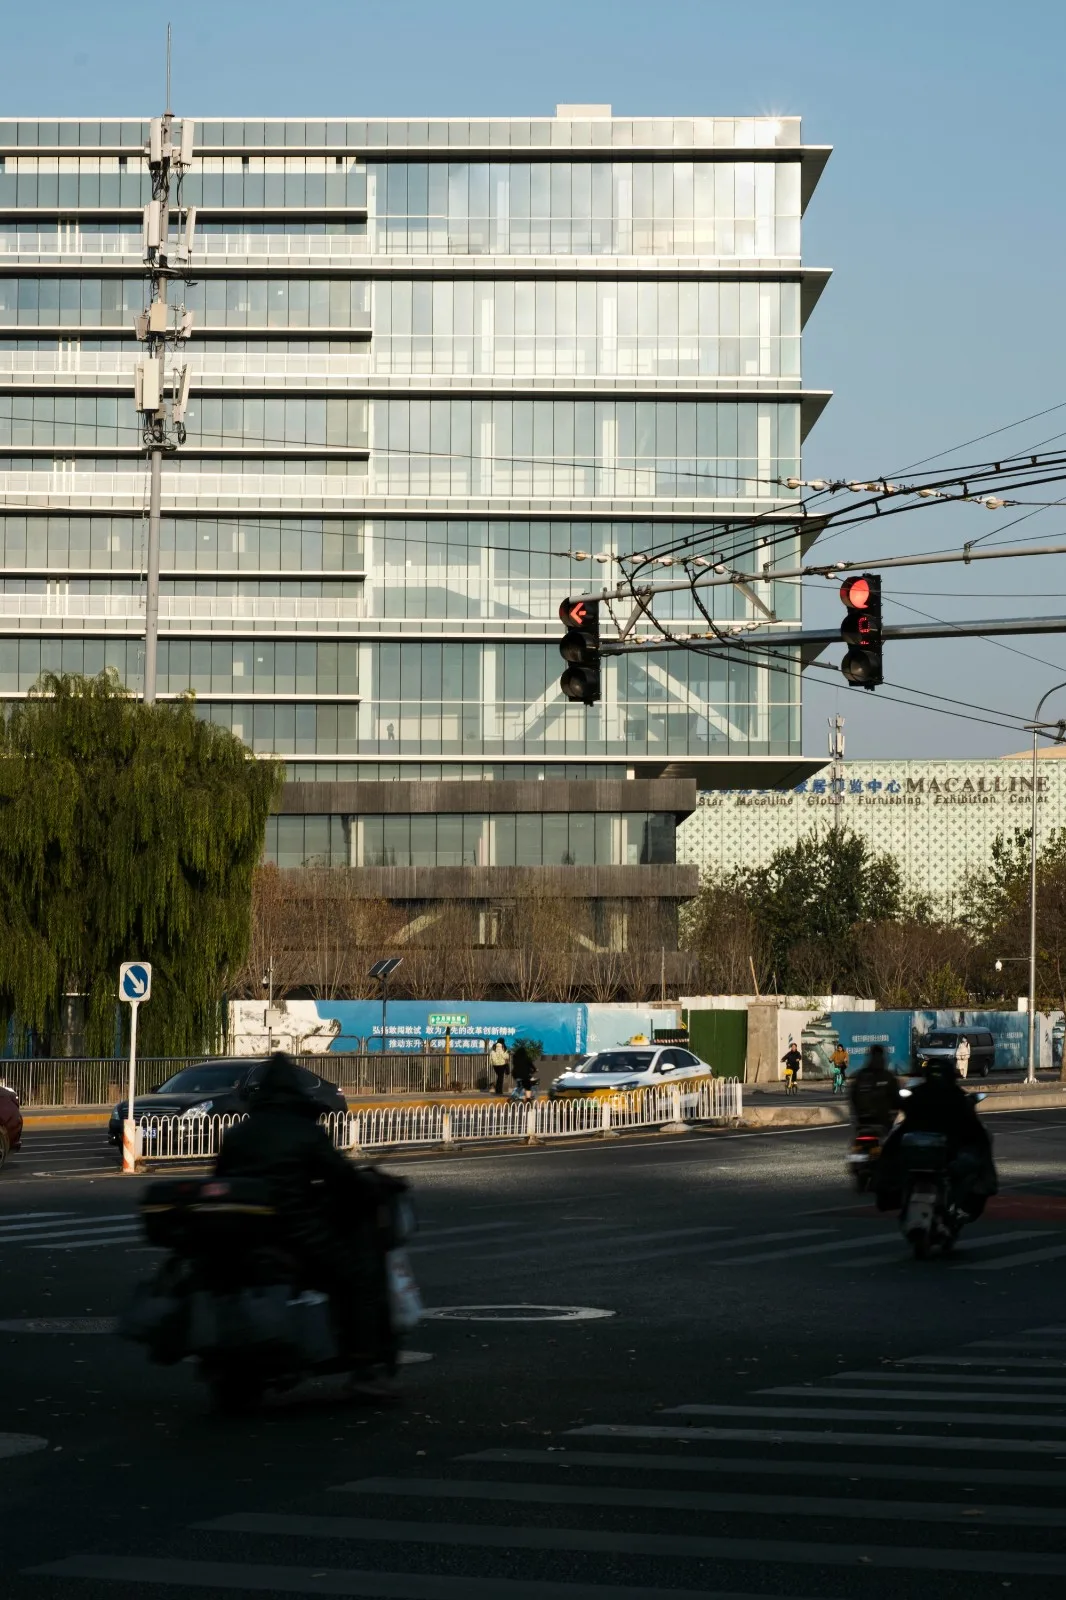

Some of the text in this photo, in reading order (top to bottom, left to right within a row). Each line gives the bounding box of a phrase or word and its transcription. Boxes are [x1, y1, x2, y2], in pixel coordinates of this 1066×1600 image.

[906, 777, 1051, 793] MACALLINE
[698, 793, 1049, 806] Star Macalline Globl Furnishing Exhibition Cener
